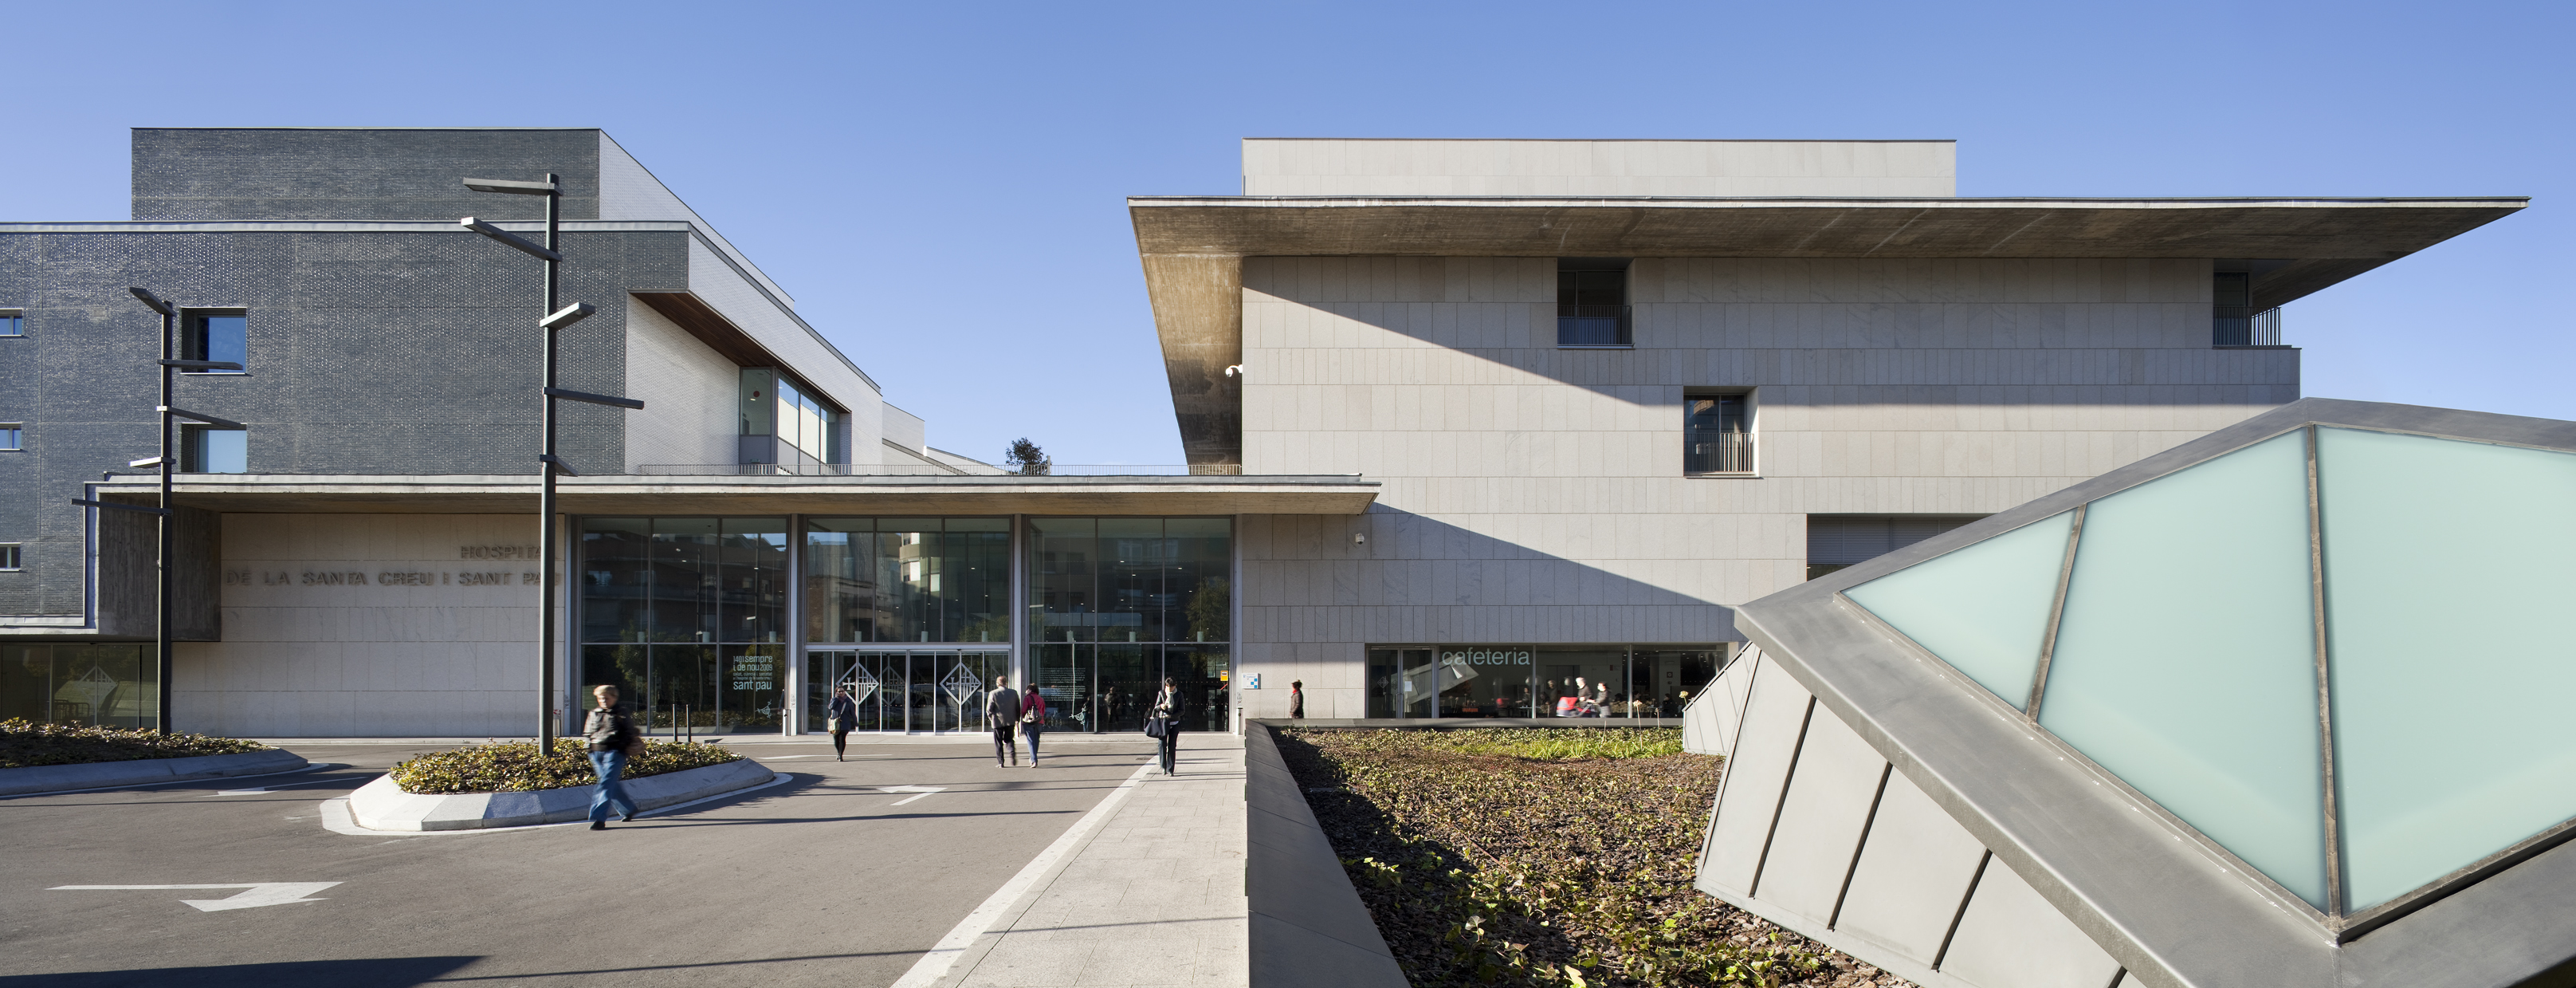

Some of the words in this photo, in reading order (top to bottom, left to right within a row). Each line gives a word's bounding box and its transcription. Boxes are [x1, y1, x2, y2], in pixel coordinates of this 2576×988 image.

[461, 545, 560, 559] HOSPITA
[227, 571, 252, 586] DE
[265, 571, 292, 586] LA
[302, 571, 367, 586] SANTA
[378, 572, 434, 586] CREU
[443, 572, 450, 586] I
[459, 572, 512, 586] SANT
[1442, 647, 1530, 665] cafeteria
[733, 662, 736, 671] i
[737, 662, 745, 671] de
[733, 680, 753, 690] sant
[756, 681, 772, 691] pau
